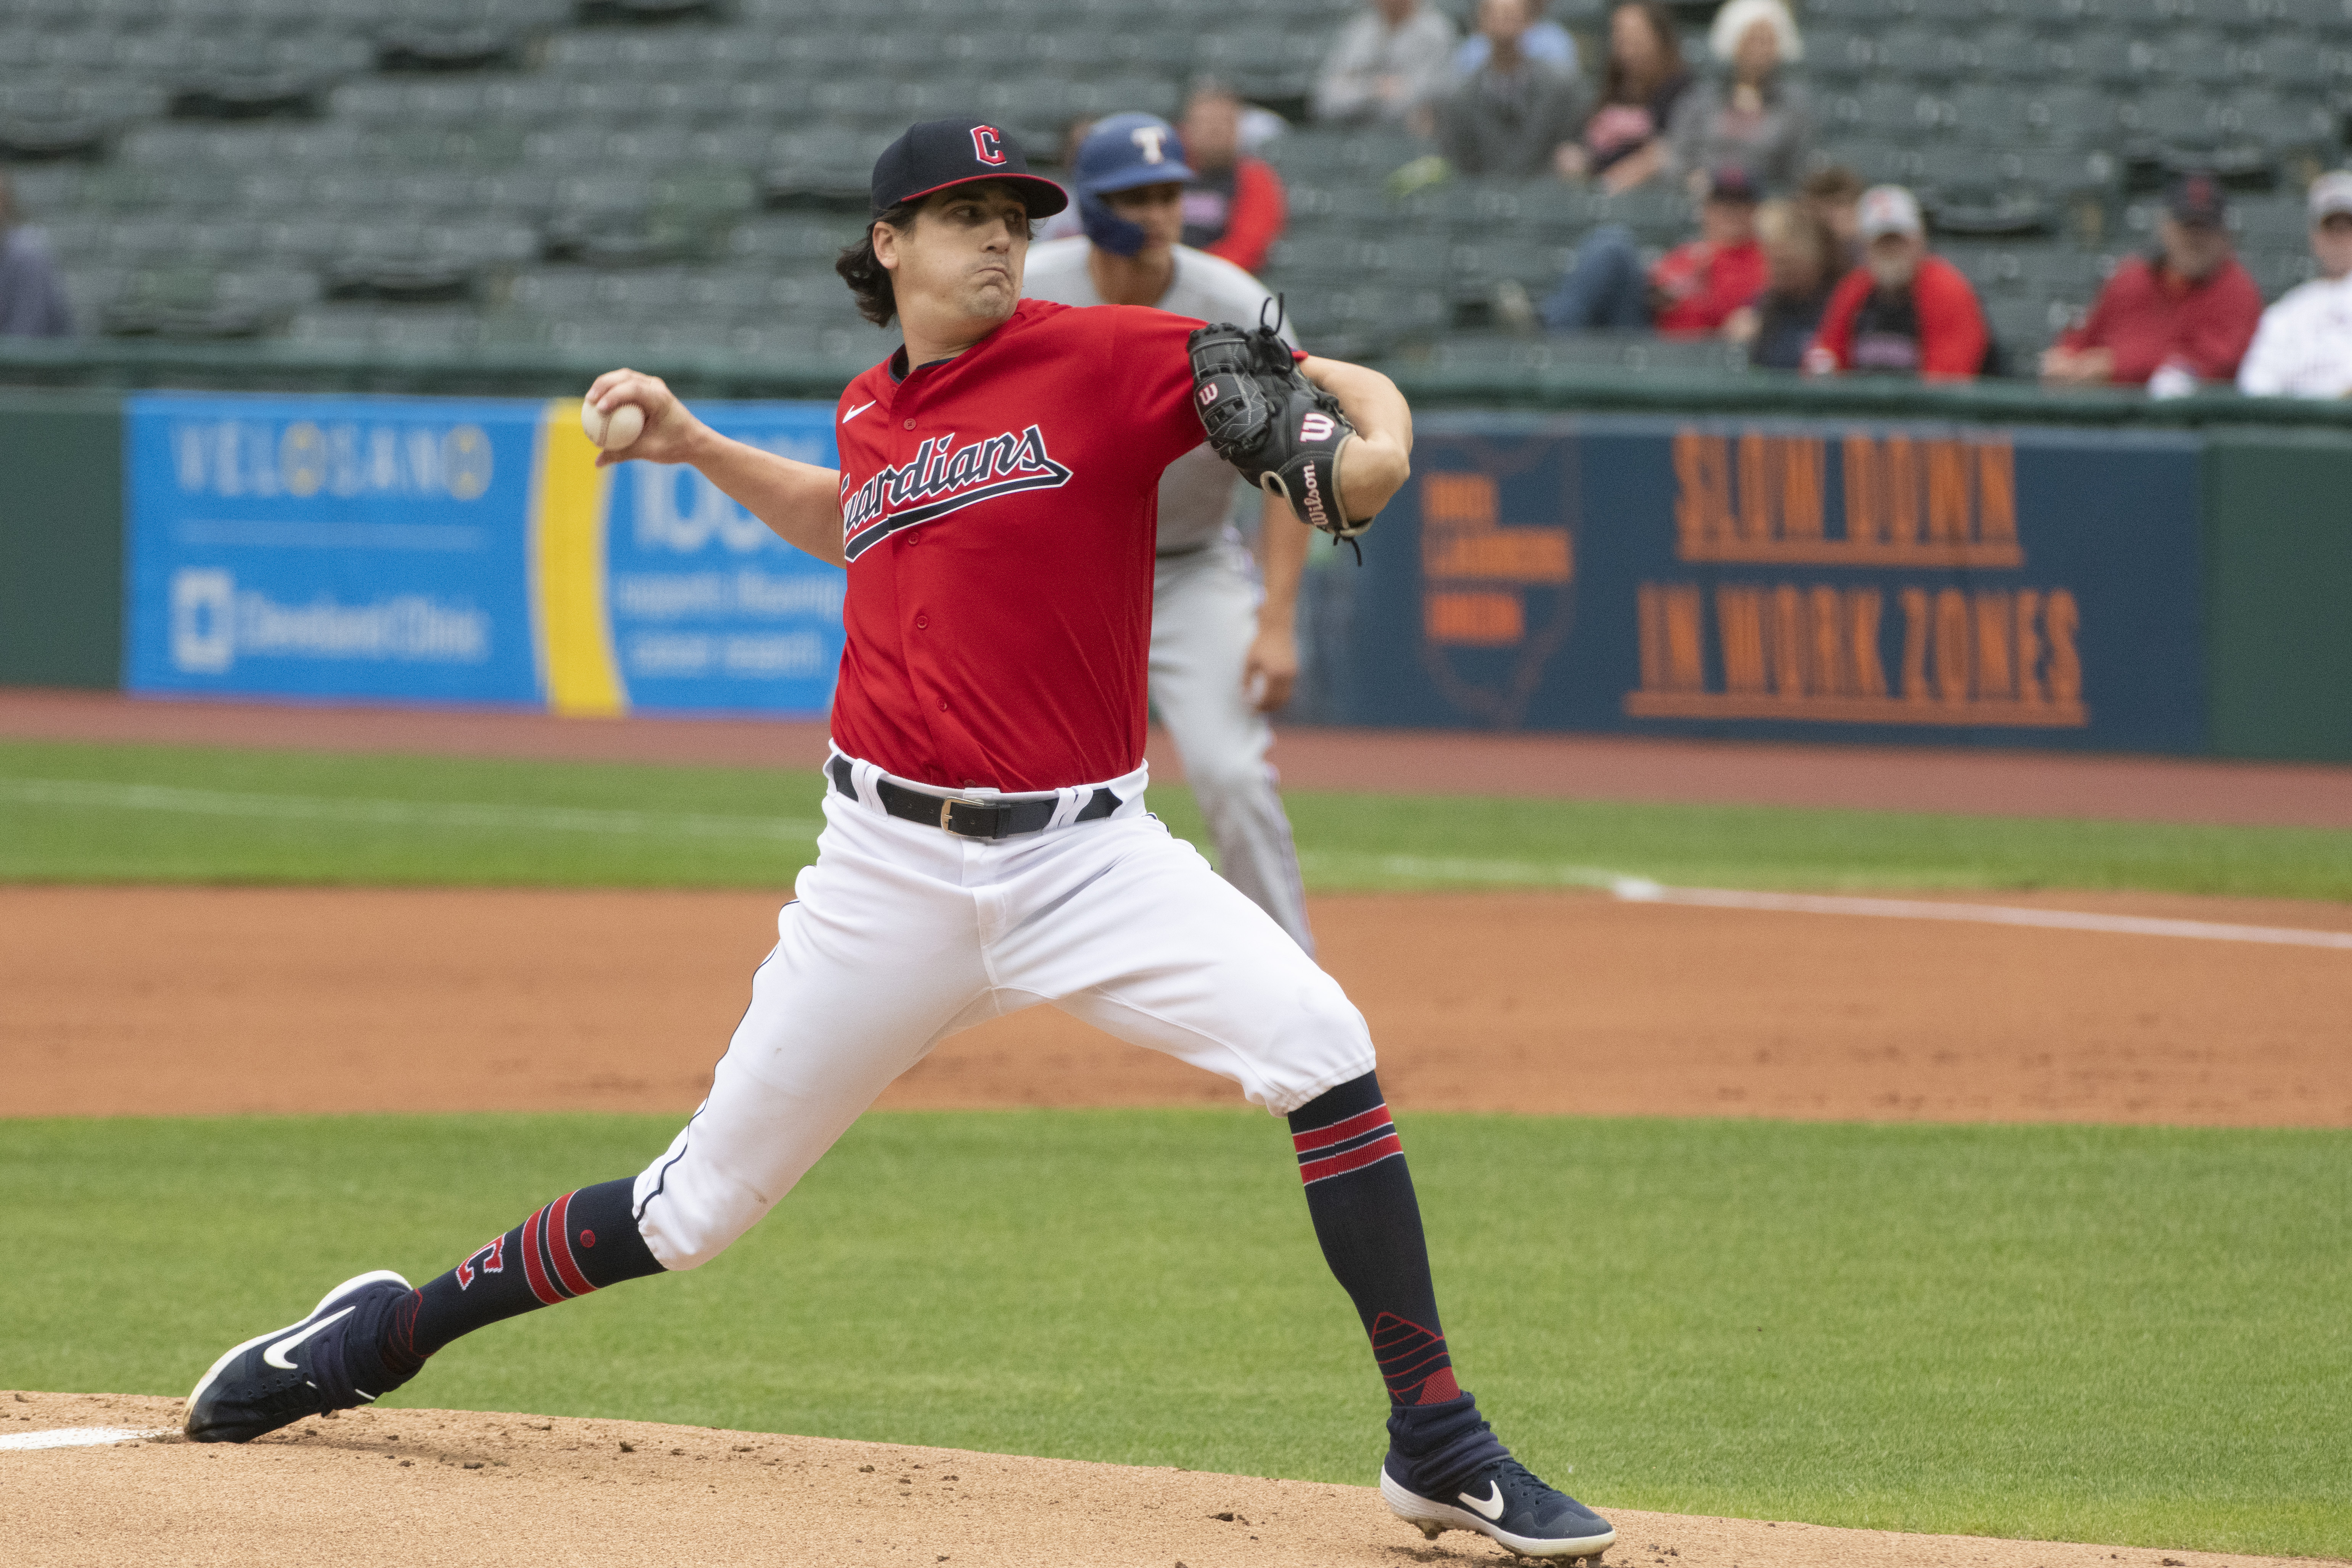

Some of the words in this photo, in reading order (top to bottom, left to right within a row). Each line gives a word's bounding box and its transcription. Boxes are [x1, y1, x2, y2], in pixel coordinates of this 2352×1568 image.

[970, 125, 1007, 166] C
[1131, 126, 1166, 164] T
[1300, 413, 1335, 443] W
[1303, 463, 1329, 526] Wilson
[1672, 426, 1825, 545] SLOW
[1842, 428, 2016, 548] DOWN
[1638, 581, 1704, 693] IN
[1716, 582, 1889, 700] WORK
[1899, 587, 2082, 704] ZONES
[456, 1232, 508, 1291] C
